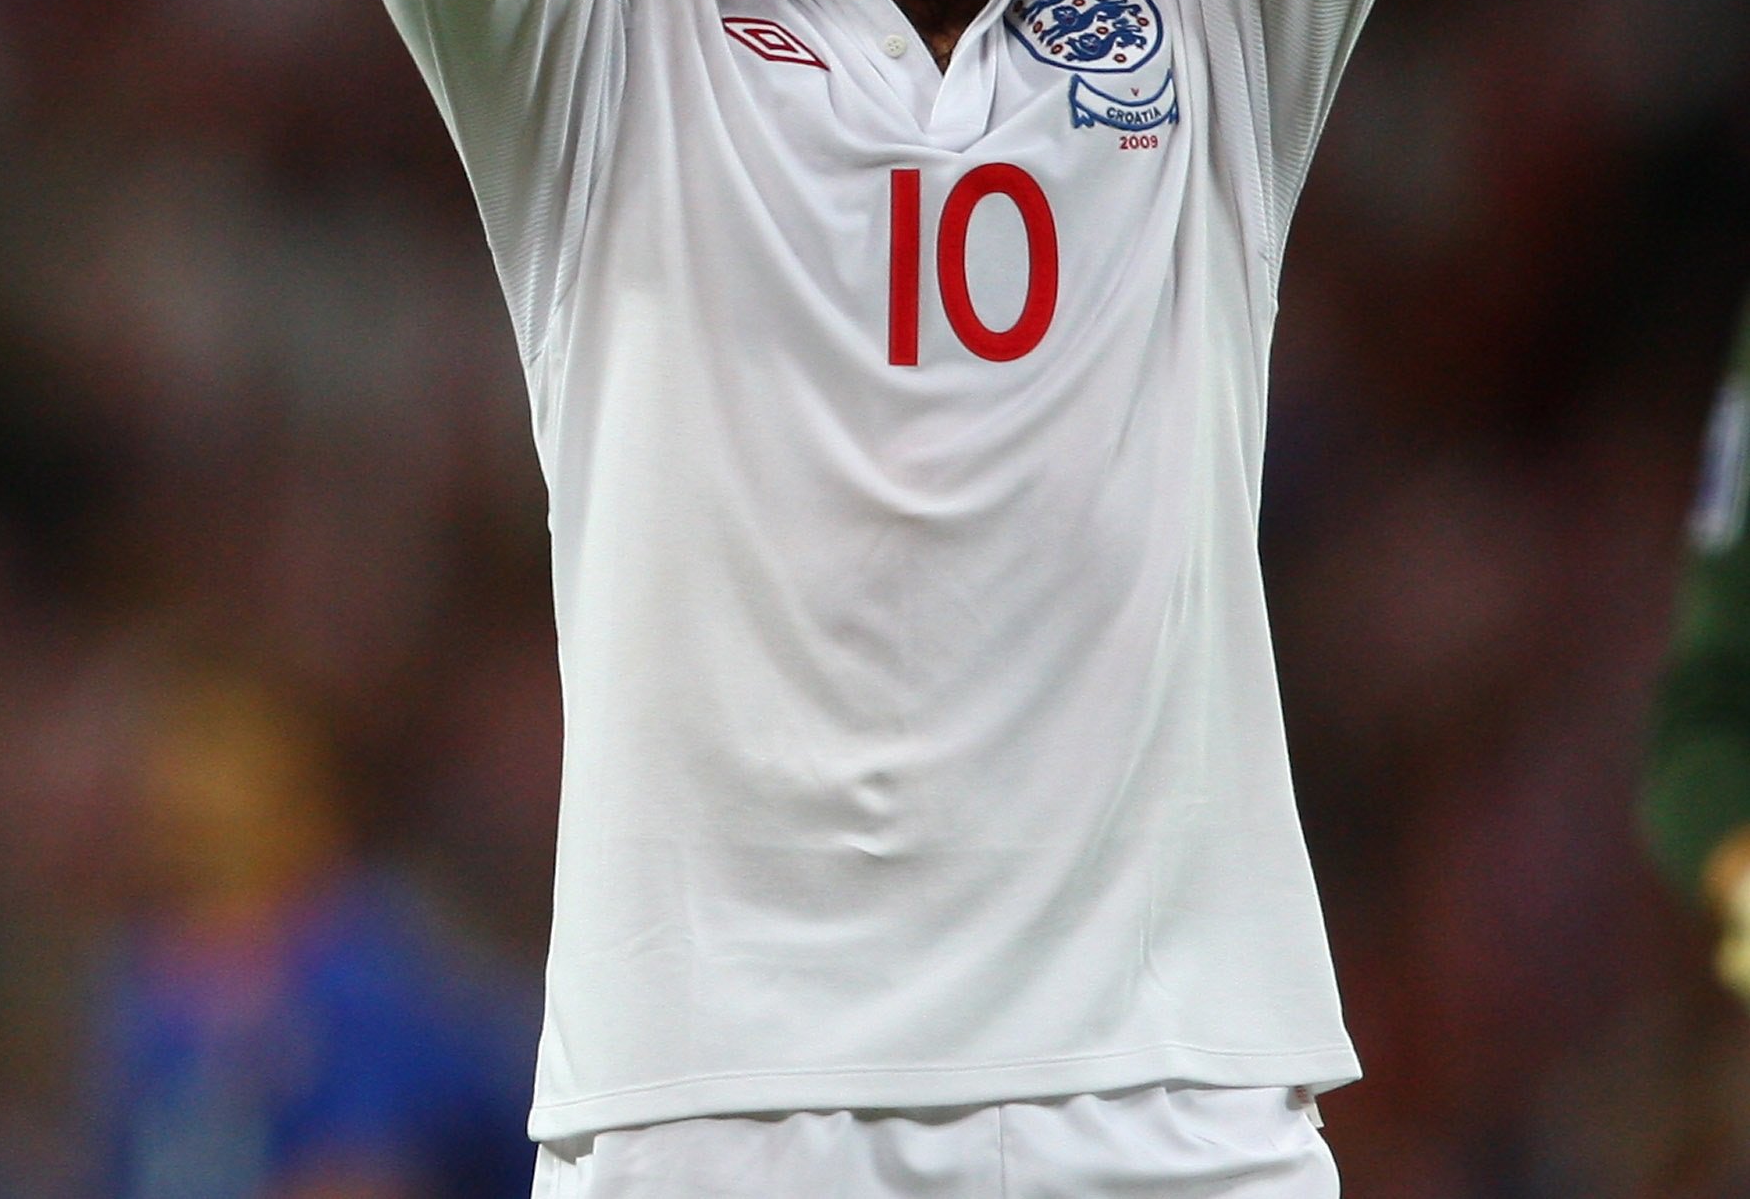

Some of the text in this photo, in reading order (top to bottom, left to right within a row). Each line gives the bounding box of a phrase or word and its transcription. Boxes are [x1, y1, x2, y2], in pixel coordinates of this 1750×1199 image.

[1106, 106, 1162, 124] CROATIA
[1119, 134, 1158, 150] 2009
[888, 162, 1059, 367] 10
